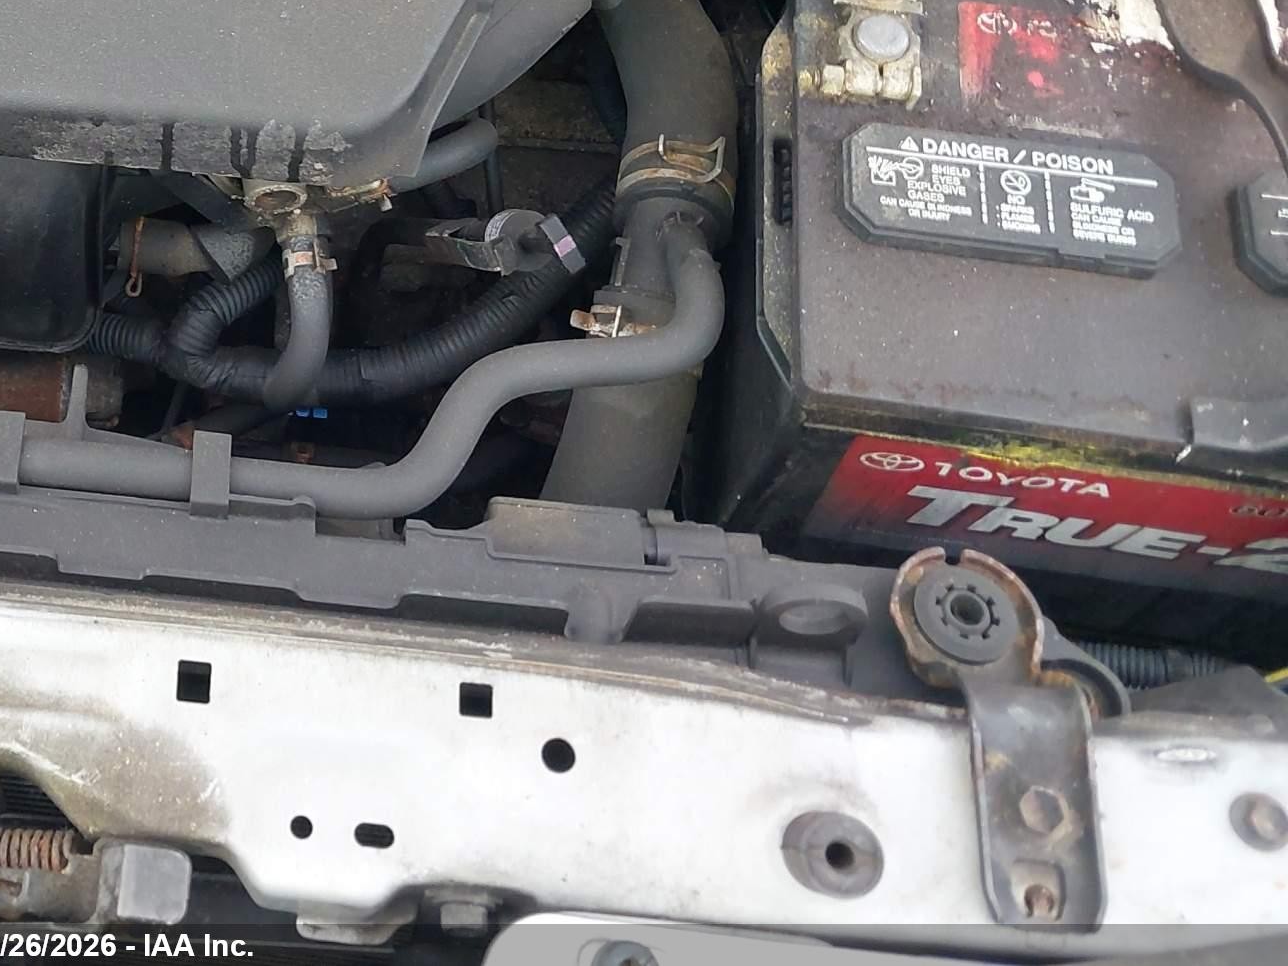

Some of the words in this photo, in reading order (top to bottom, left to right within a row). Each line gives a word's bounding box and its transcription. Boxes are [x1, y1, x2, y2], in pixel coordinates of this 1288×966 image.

[922, 137, 1010, 163] DANGER
[1032, 151, 1114, 175] POISON
[931, 164, 971, 178] SHIELD
[932, 174, 961, 186] EYES
[907, 180, 967, 197] EXPLOSIVE
[880, 195, 897, 206] CAN
[907, 190, 945, 203] GASES
[1007, 194, 1026, 206] NO
[1070, 202, 1125, 219] SULFURIC
[1127, 209, 1155, 224] ACID
[934, 462, 1110, 498] TOYOTA
